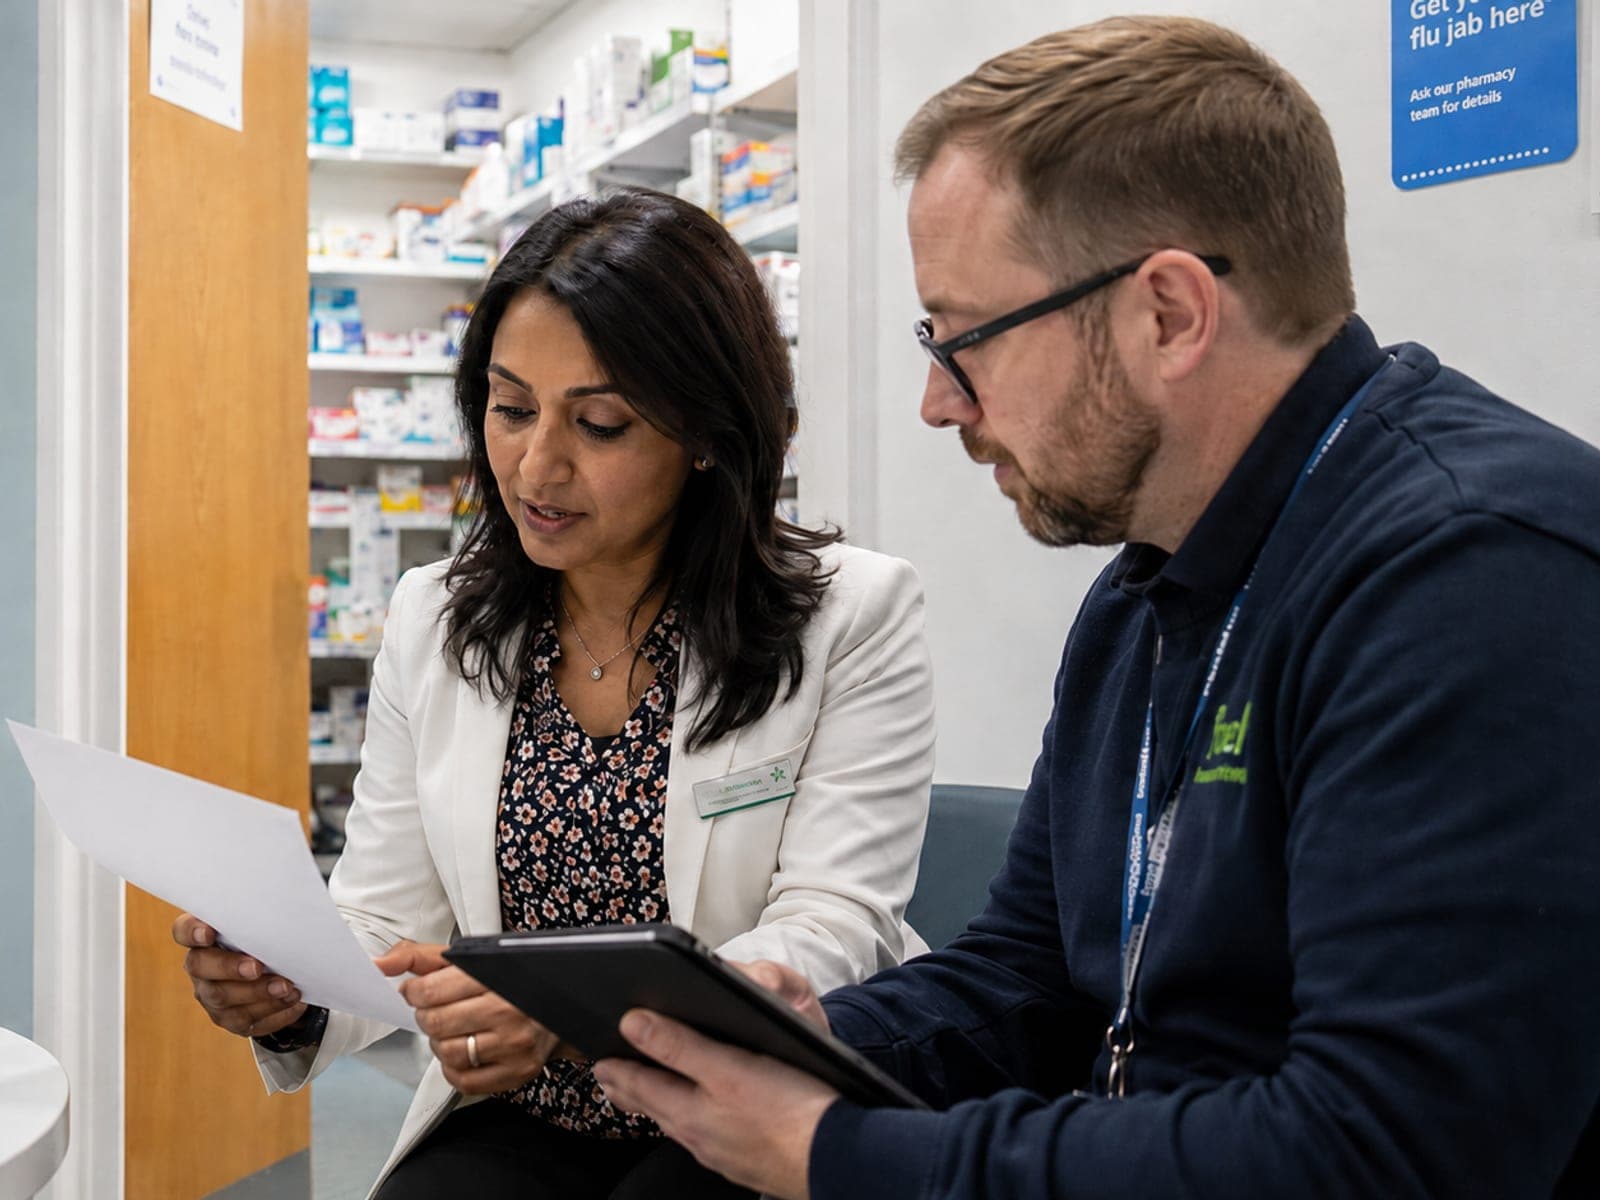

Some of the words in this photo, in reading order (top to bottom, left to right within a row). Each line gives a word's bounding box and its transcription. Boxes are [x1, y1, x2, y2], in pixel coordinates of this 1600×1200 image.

[1409, 24, 1440, 50] flu
[1445, 11, 1483, 47] jab
[1490, 0, 1544, 29] here
[1410, 86, 1431, 102] Ask
[1433, 82, 1454, 96] our
[1456, 67, 1516, 94] pharmacy
[1410, 106, 1439, 122] team
[1442, 100, 1460, 114] for
[1462, 90, 1502, 109] details
